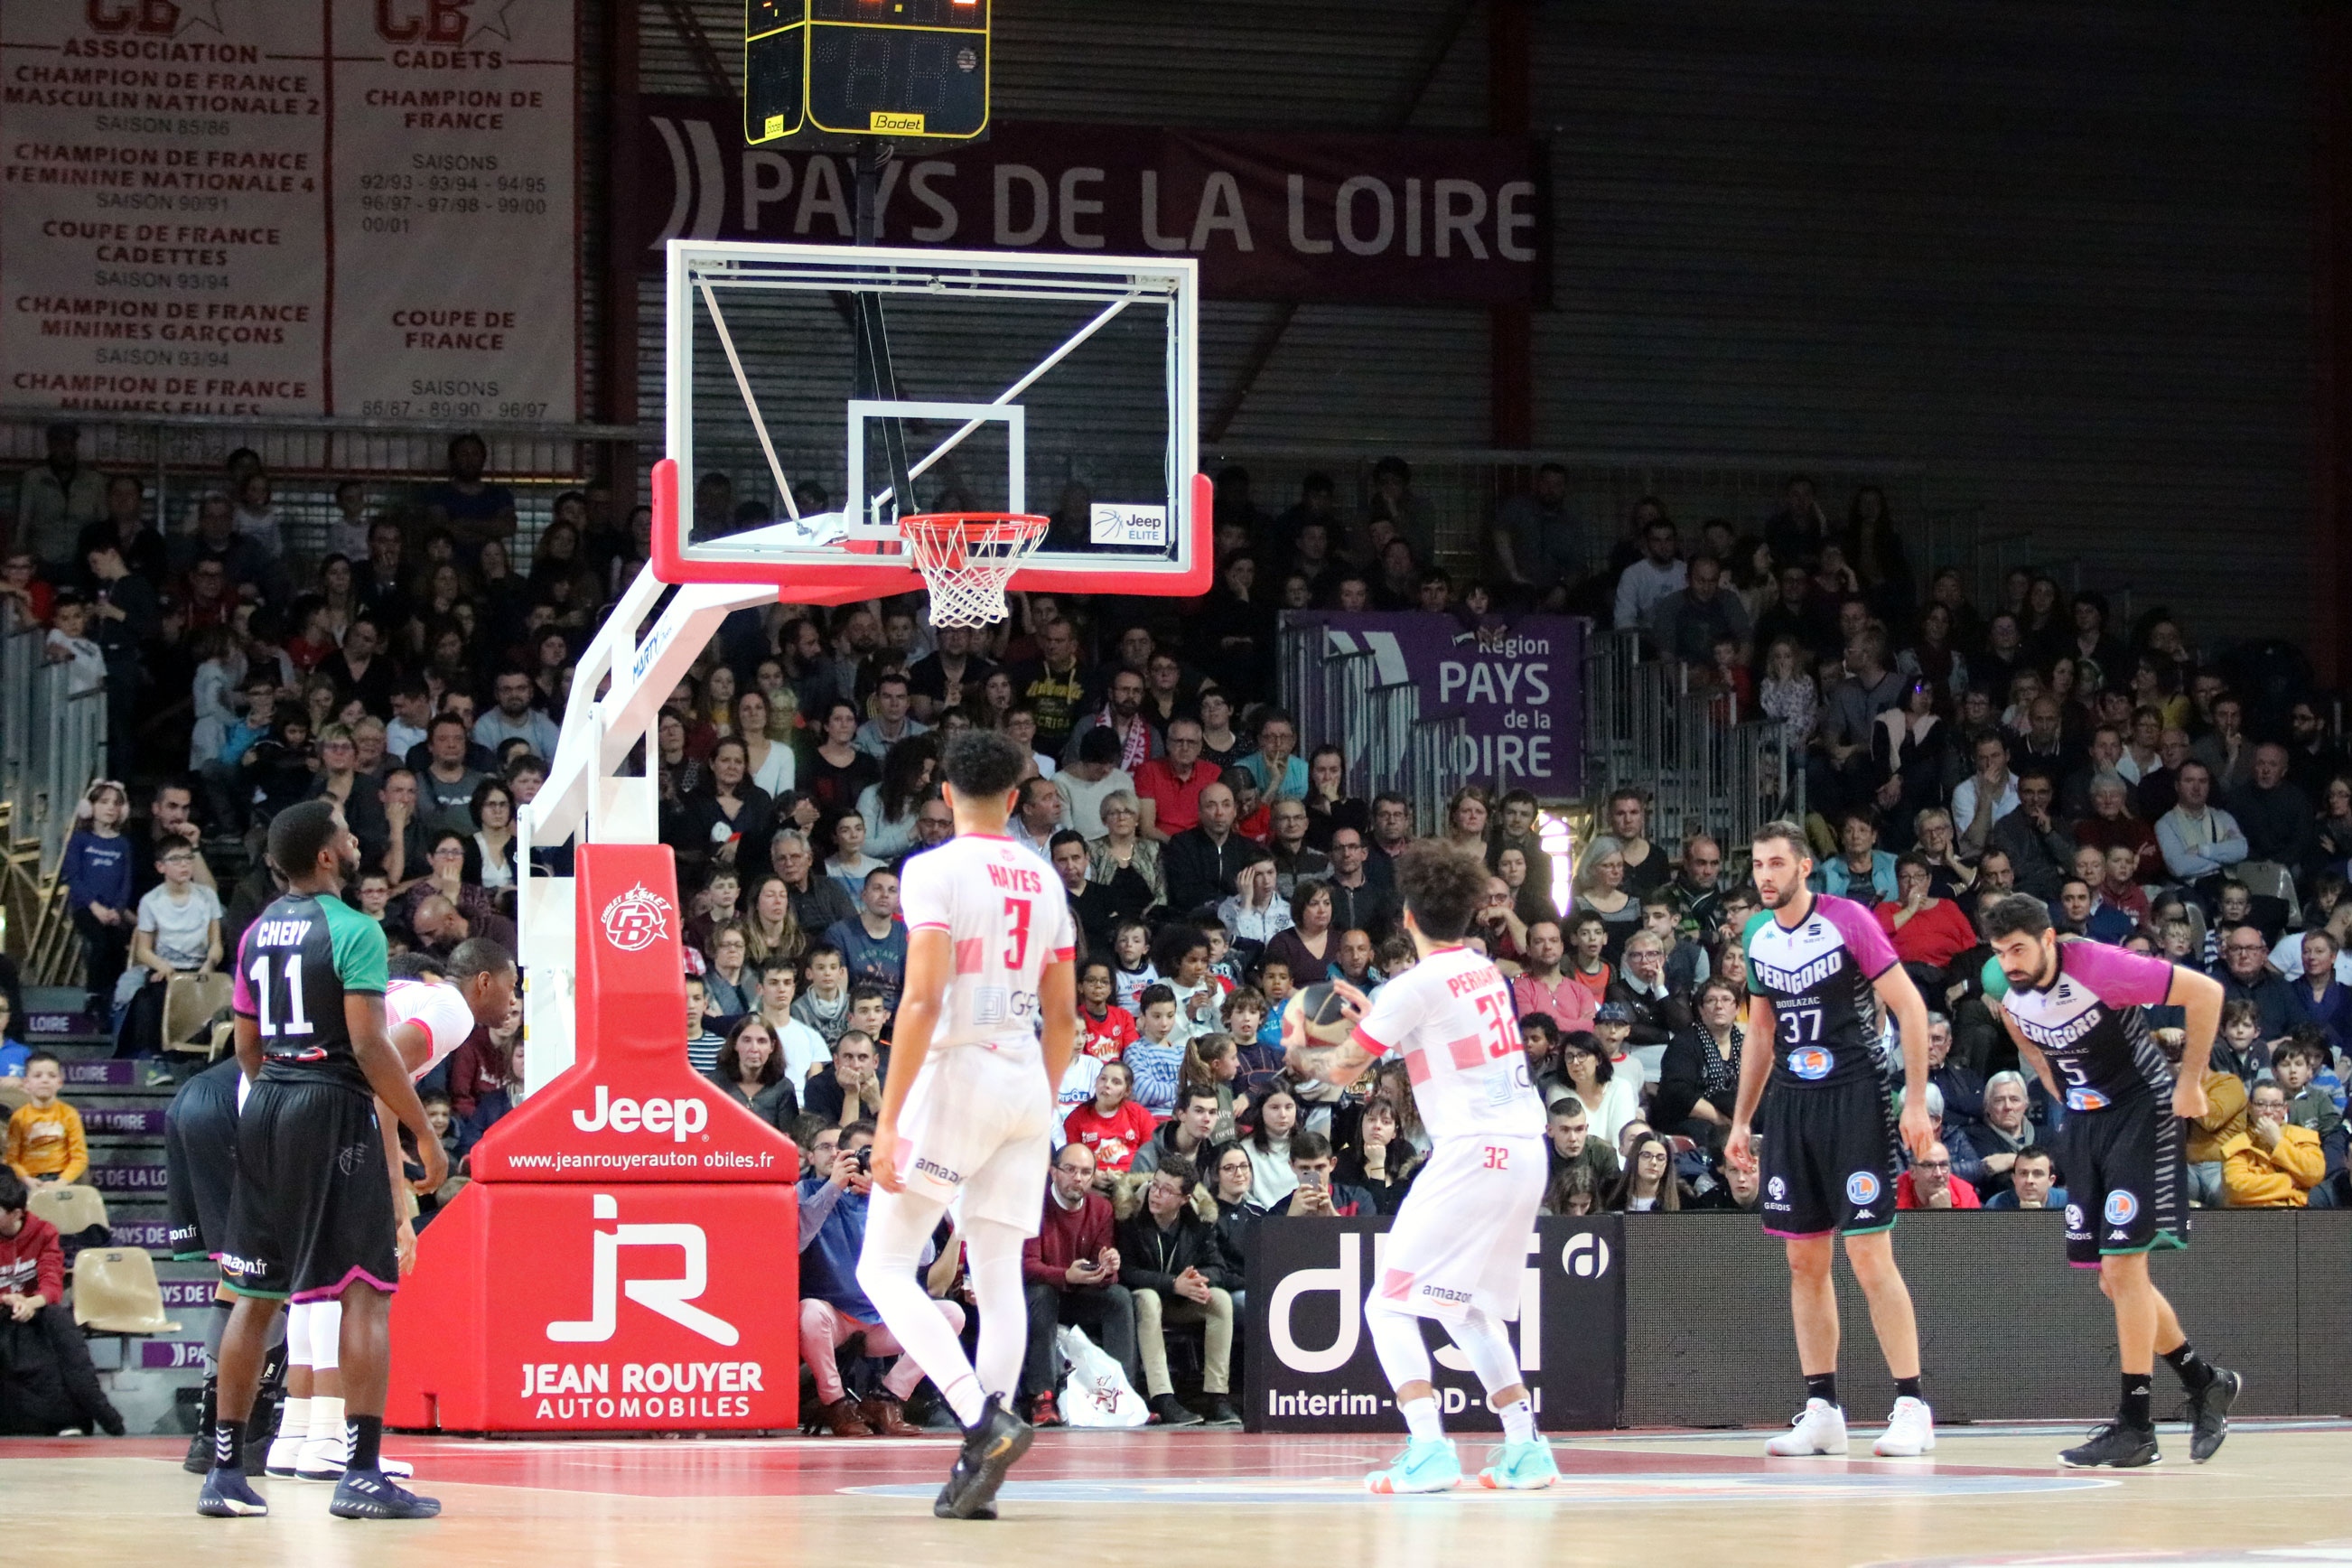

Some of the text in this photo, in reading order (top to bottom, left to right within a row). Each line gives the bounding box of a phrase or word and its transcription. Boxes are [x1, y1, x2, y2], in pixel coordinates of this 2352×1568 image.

[63, 39, 258, 63] ASSOCIATION
[393, 50, 502, 70] CADETS
[16, 65, 308, 93] CHAMPION DE FRANCE
[4, 87, 320, 115] MASCULIN NATIONALE 2
[365, 89, 543, 107] CHAMPION DE
[97, 116, 173, 134] SAISON
[404, 113, 504, 130] FRANCE
[873, 114, 921, 130] Bodet
[15, 143, 308, 171] CHAMPION DE FRANCE
[413, 154, 499, 171] SAISONS
[6, 165, 314, 193] FEMININE NATIONALE 4
[97, 192, 173, 210] SAISON
[742, 149, 1536, 262] PAYS DE LA LOIRE
[42, 220, 281, 246] COUPE DE FRANCE
[97, 246, 228, 266] CADETTES
[95, 269, 229, 290] SAISON 93/94
[15, 295, 310, 323] CHAMPION DE FRANCE
[392, 310, 516, 329] COUPE DE
[41, 320, 285, 347] MINIMES GARÇONS
[405, 331, 504, 350] FRANCE
[96, 349, 230, 368] SAISON 93/94
[13, 373, 306, 399] CHAMPION DE FRANCE
[412, 380, 499, 397] SAISONS
[61, 398, 261, 416] MINIMES FILLES
[1126, 514, 1161, 529] Jeep
[1129, 528, 1159, 540] ÉLITE
[1440, 661, 1549, 705] PAYS
[1504, 710, 1551, 729] de la
[986, 863, 1041, 894] HAYES
[601, 895, 622, 924] CHOLET
[1003, 896, 1031, 971] 3
[1754, 951, 1842, 995] PÉRIGORD
[249, 954, 314, 1037] 11
[1776, 996, 1821, 1009] BOULAZAC
[29, 1017, 70, 1032] LOIRE
[1475, 991, 1525, 1059] 32
[1779, 1009, 1822, 1044] 37
[69, 1066, 108, 1081] LOIRE
[2057, 1059, 2088, 1086] 5
[106, 1115, 146, 1130] LOIRE
[572, 1085, 707, 1142] Jeep
[1483, 1146, 1509, 1170] 32
[107, 1171, 126, 1185] DE
[129, 1170, 147, 1185] LA
[1764, 1202, 1791, 1212] GEODIS
[146, 1227, 165, 1243] DE
[184, 1286, 204, 1302] DE
[188, 1347, 207, 1364] PA
[521, 1362, 764, 1398] JEAN ROUYER
[536, 1396, 750, 1418] AUTOMOBILES
[1268, 1388, 1377, 1416] Interim
